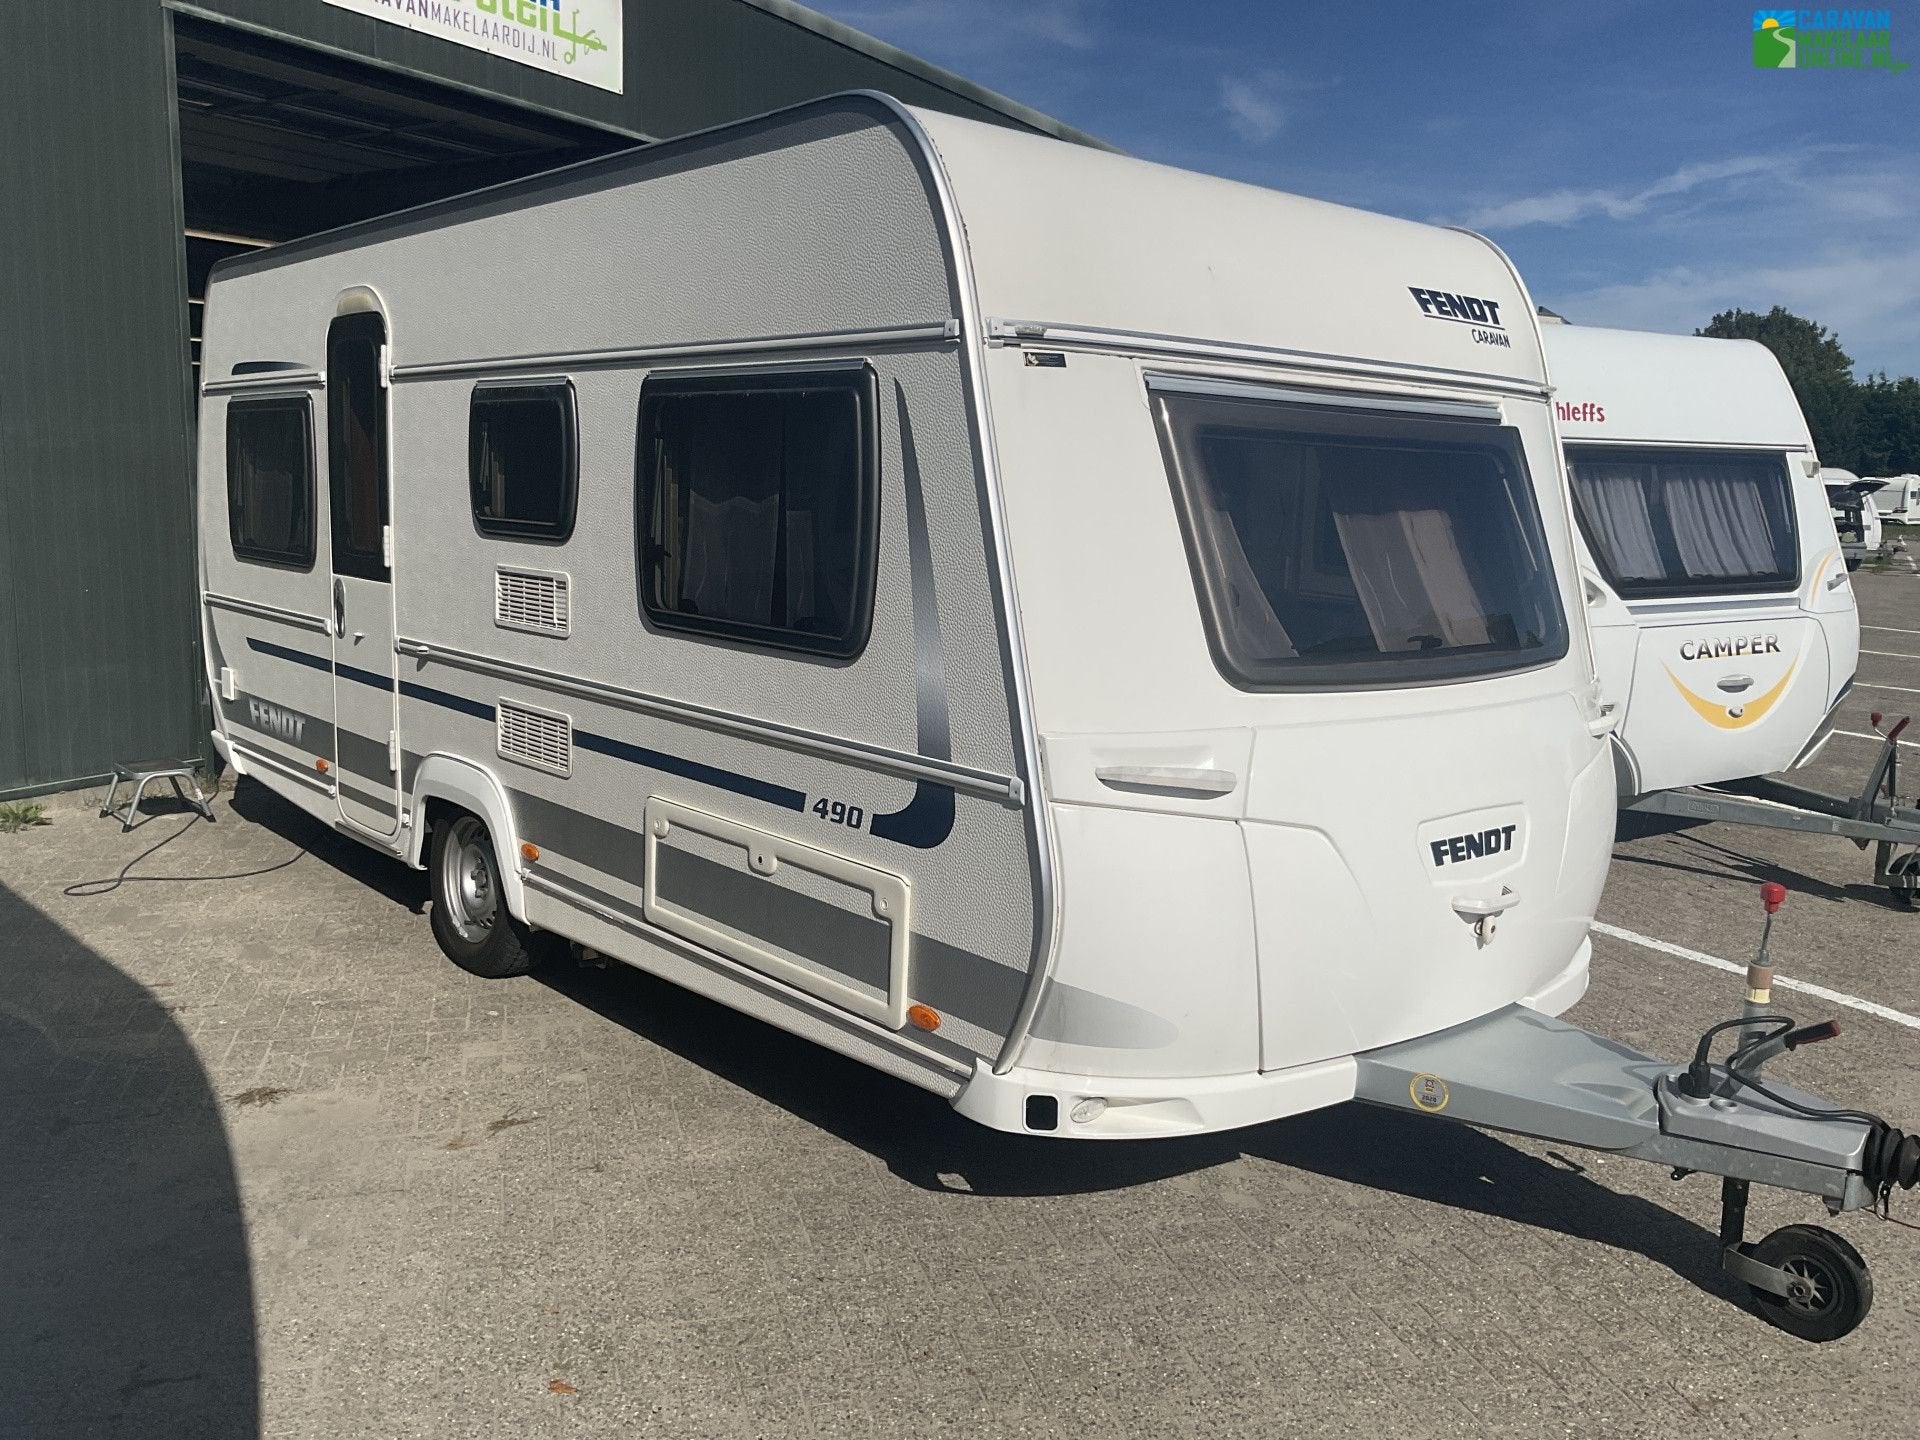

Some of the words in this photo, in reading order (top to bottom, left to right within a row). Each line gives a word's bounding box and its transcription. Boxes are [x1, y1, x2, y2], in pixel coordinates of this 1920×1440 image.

[1408, 287, 1501, 325] FENDT
[1471, 328, 1511, 348] CARAVAN
[1679, 633, 1781, 661] CAMPER
[249, 698, 306, 743] FENDT
[812, 797, 864, 830] 490
[1430, 824, 1517, 867] FENDT
